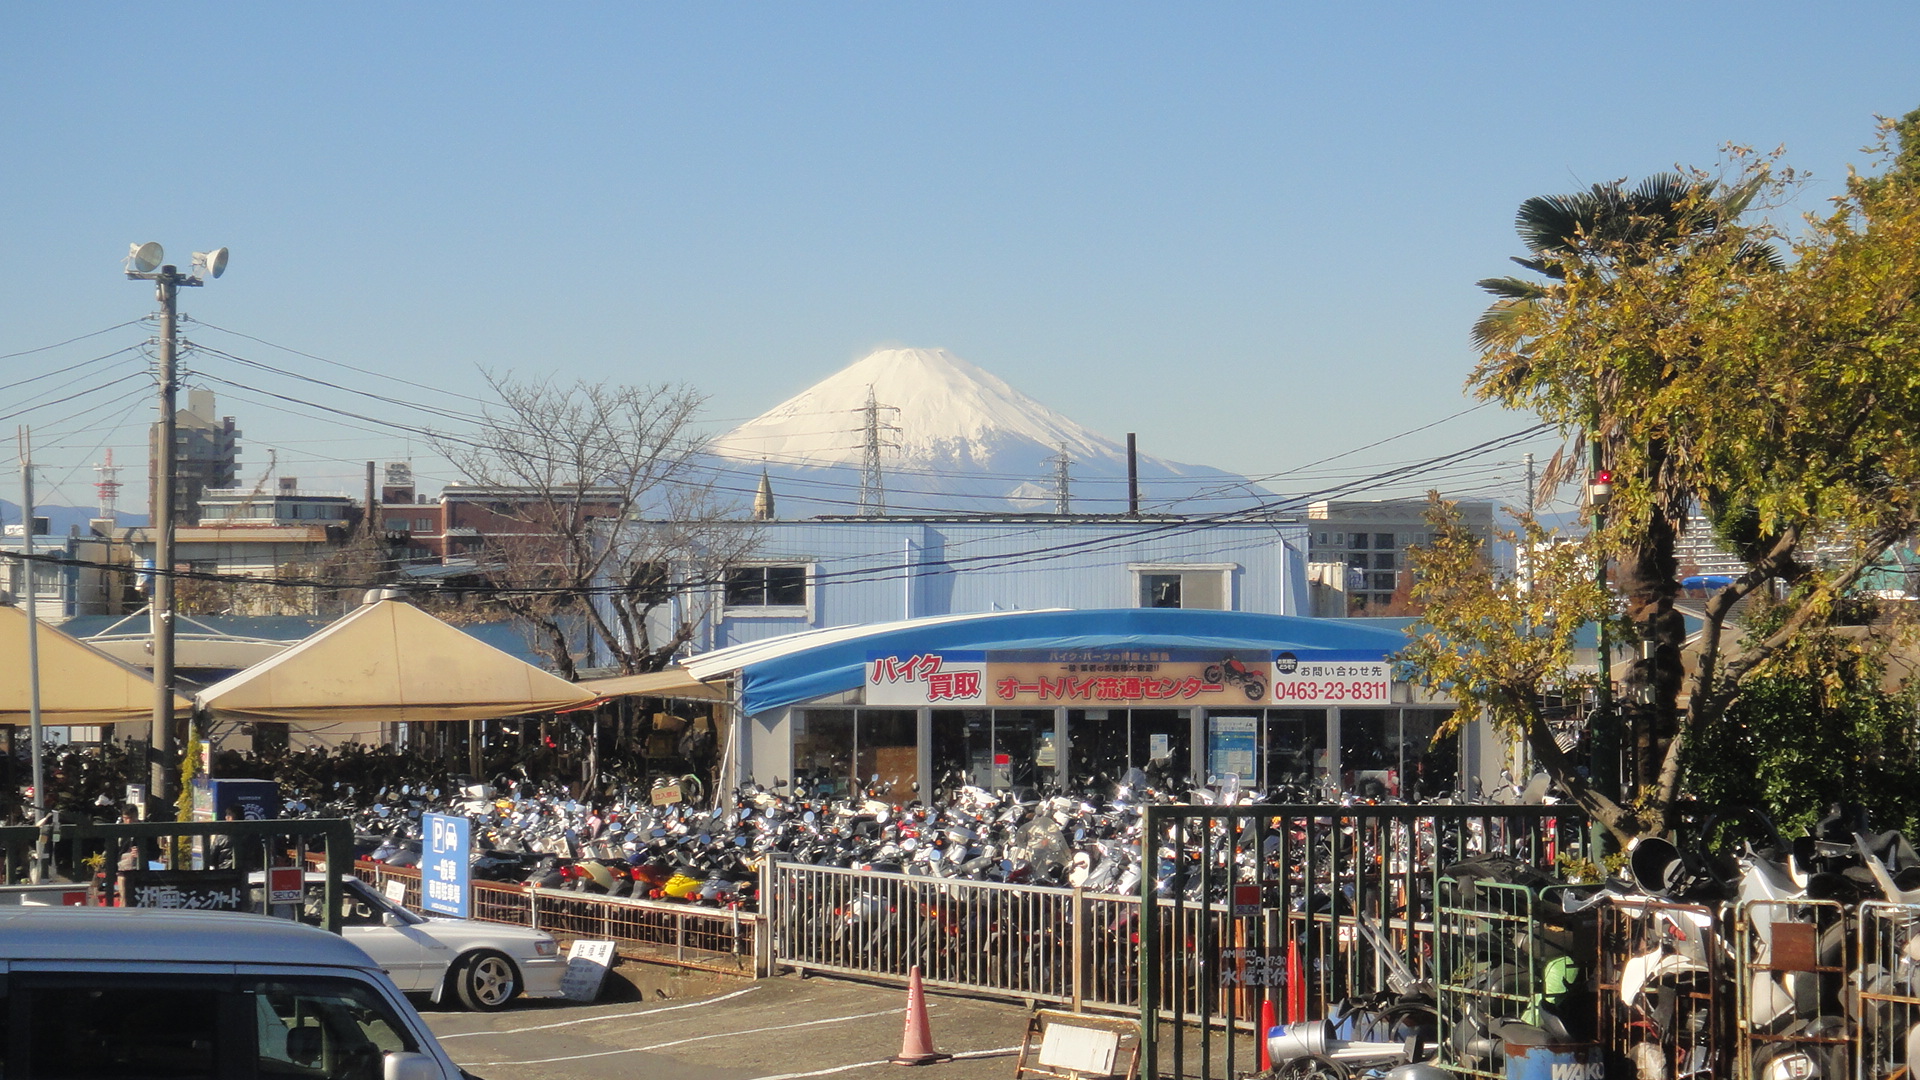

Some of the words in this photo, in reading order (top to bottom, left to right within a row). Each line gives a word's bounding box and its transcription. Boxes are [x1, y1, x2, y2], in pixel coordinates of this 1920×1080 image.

[872, 653, 942, 683] バイク
[1300, 666, 1383, 677] お問い合わせ先
[926, 670, 982, 701] 買取
[997, 676, 1224, 700] オートバイ流通センター
[1275, 681, 1387, 700] 0463-23-8311
[272, 890, 301, 899] SECOM
